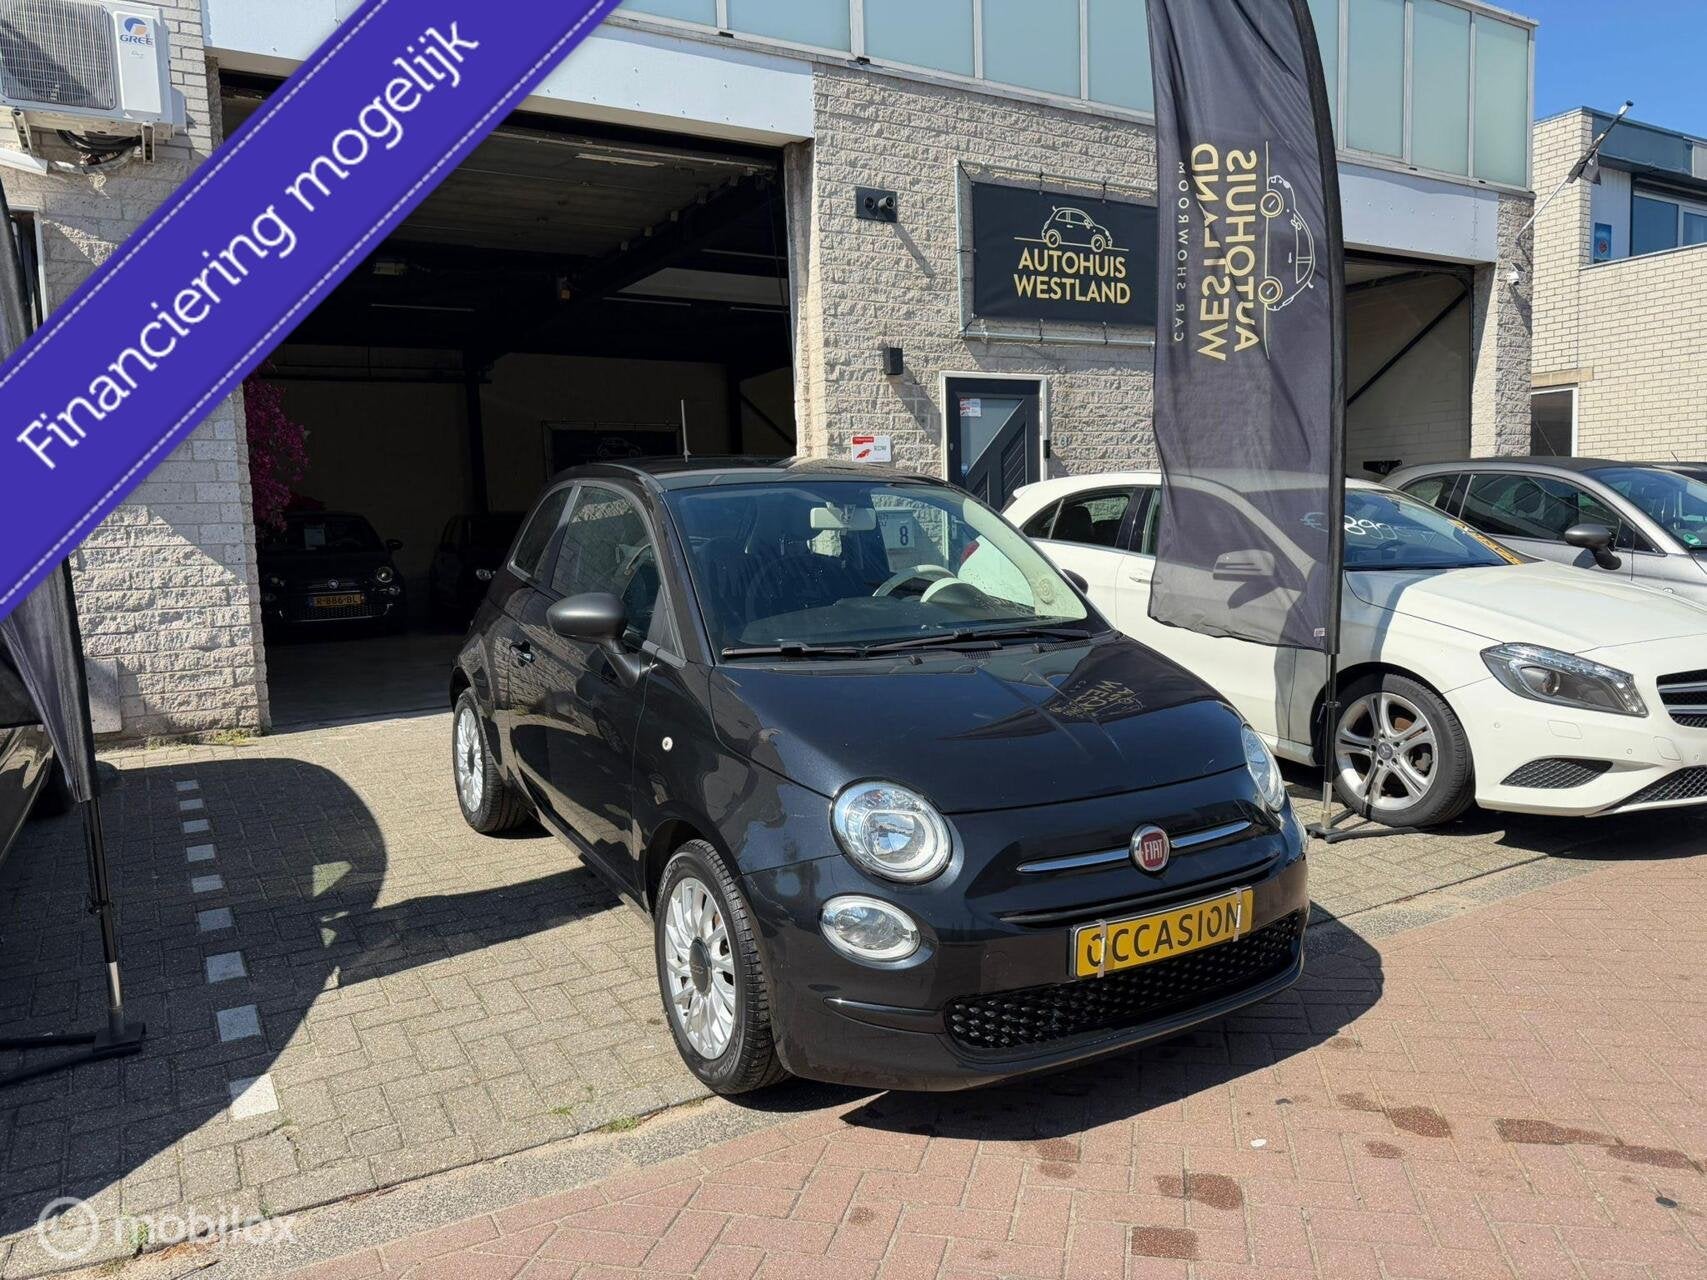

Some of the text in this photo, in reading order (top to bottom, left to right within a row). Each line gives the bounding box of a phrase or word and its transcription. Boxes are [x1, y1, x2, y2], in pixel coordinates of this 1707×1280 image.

[120, 34, 153, 46] GREE
[1018, 247, 1127, 279] AUTOHUIS
[1013, 273, 1131, 304] WESTLAND
[899, 525, 908, 546] 8
[1143, 838, 1163, 861] FIAT
[1086, 902, 1242, 968] OCCASION
